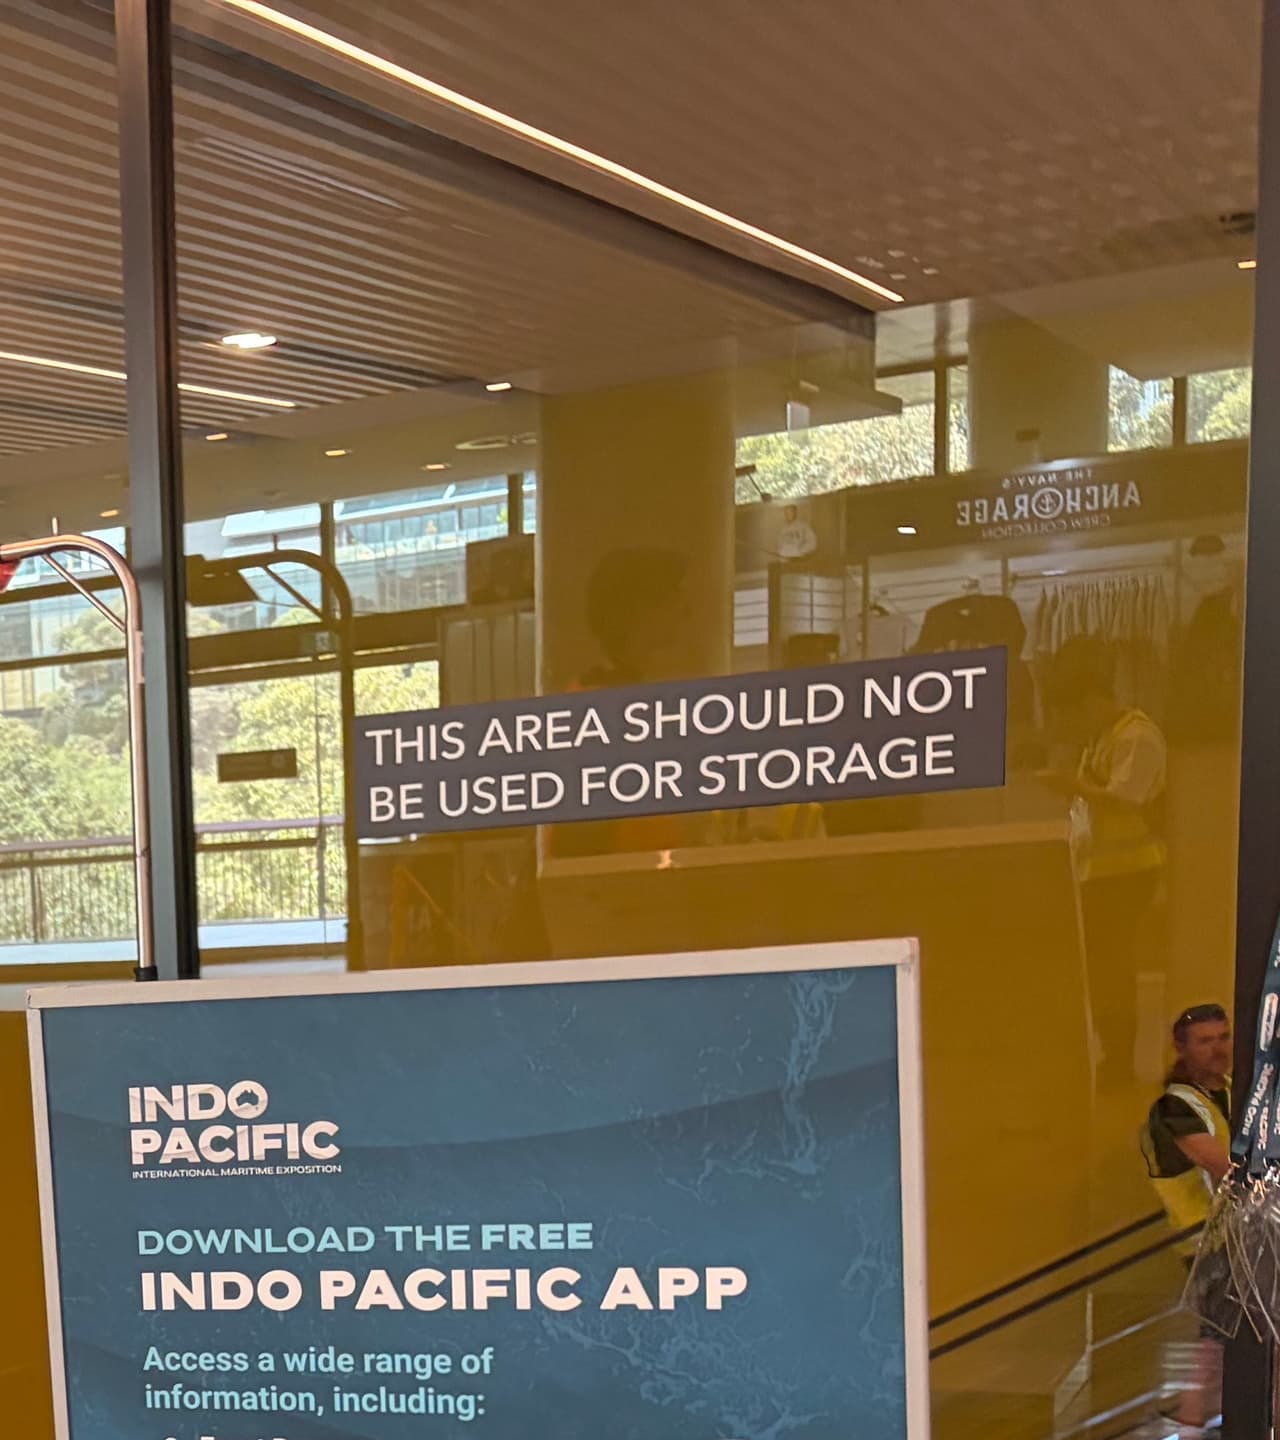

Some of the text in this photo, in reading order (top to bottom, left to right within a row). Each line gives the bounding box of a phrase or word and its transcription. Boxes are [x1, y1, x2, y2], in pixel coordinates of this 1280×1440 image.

[365, 666, 987, 767] THIS AREA SHOULD NOT
[369, 733, 956, 823] BE USED FOR STORAGE
[128, 1080, 269, 1123] INDO
[130, 1120, 340, 1165] PACIFIC
[132, 1164, 343, 1180] INTERNATIONAL MARITIME EXPOSITION
[138, 1222, 593, 1256] DOWNLOAD THE FREE
[141, 1266, 749, 1311] INDO PACIFIC APP
[143, 1346, 495, 1382] Access a wide range of
[144, 1383, 486, 1421] information, including:
